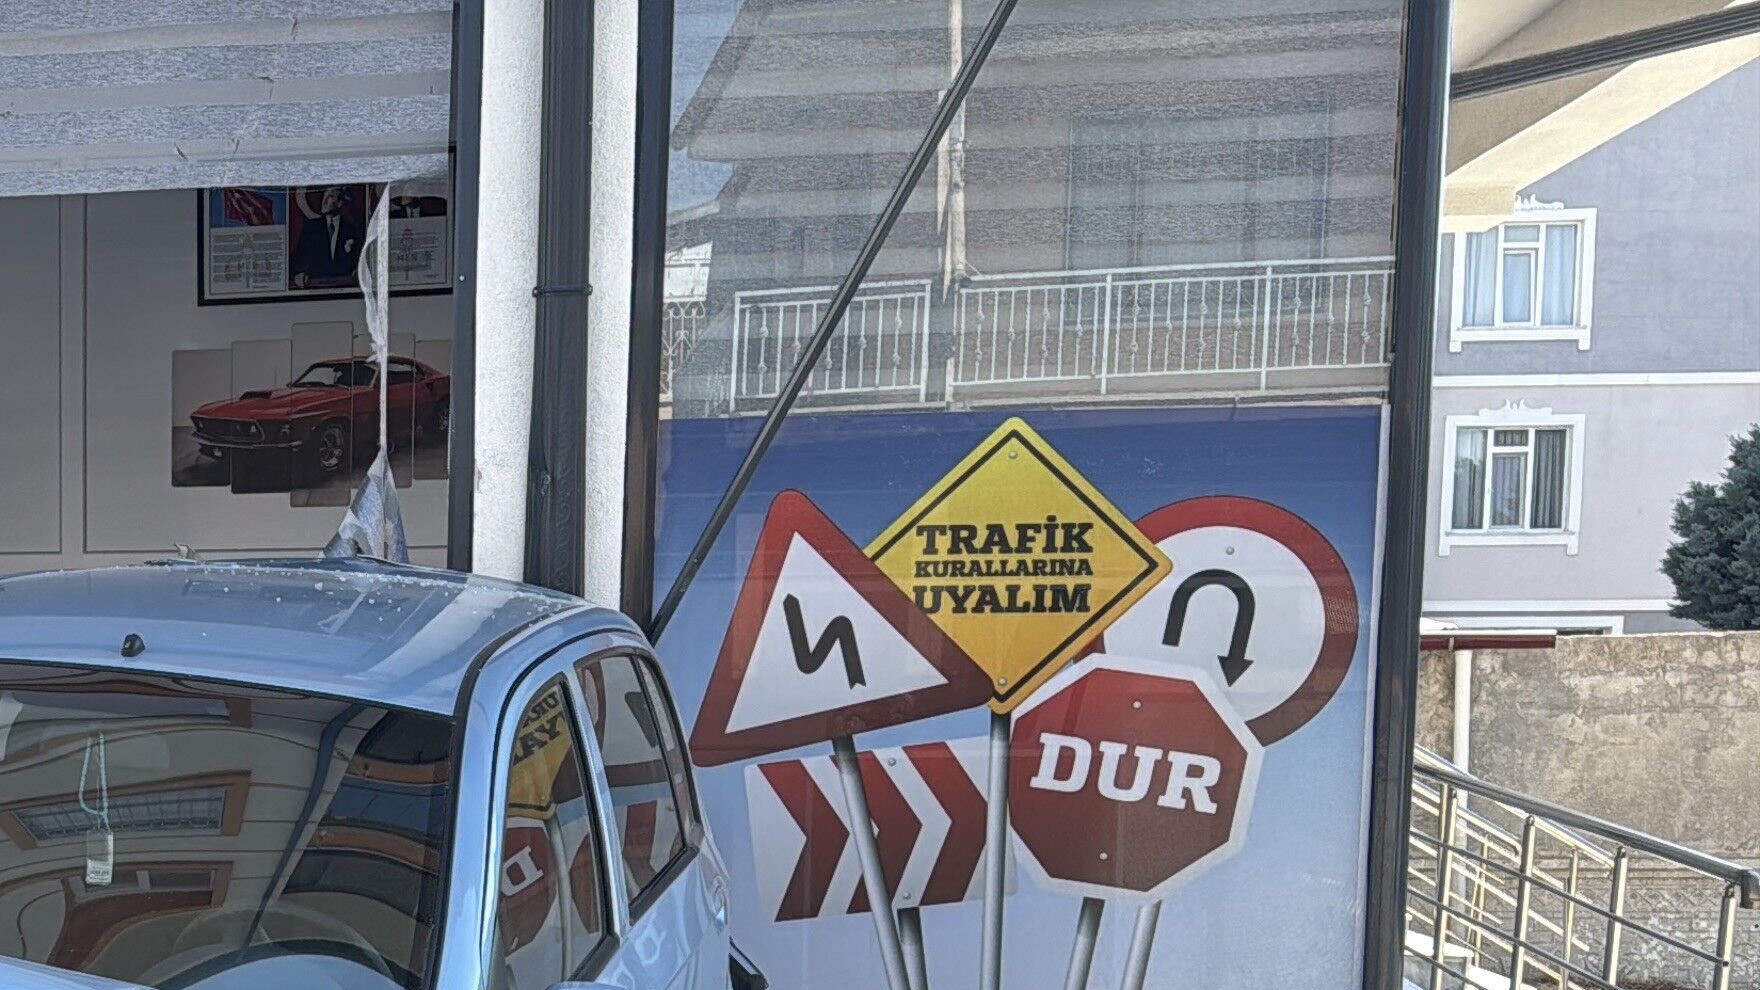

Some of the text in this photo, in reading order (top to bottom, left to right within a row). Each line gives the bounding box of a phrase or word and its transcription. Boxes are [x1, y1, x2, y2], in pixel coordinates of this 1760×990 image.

[915, 515, 1094, 555] TRAFİK
[914, 559, 1094, 577] KURALLARINA
[913, 583, 1091, 614] UYALIM
[1030, 732, 1222, 815] DUR
